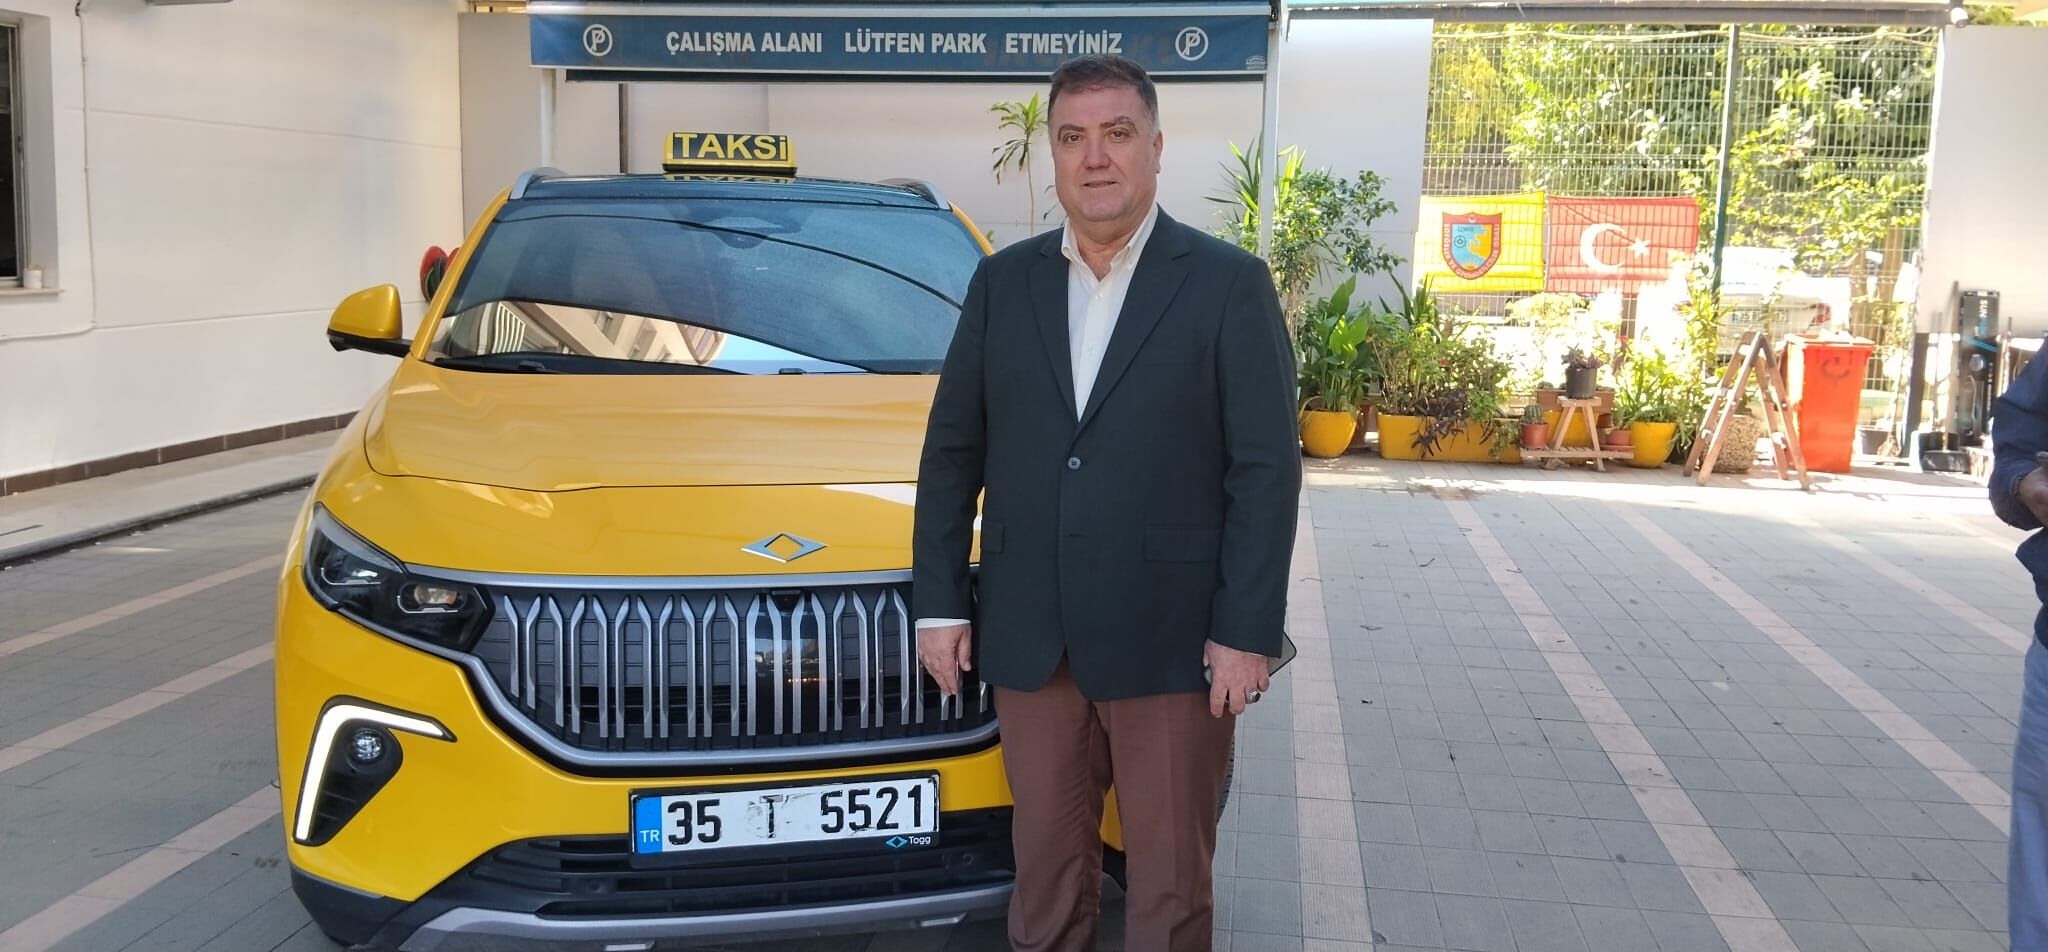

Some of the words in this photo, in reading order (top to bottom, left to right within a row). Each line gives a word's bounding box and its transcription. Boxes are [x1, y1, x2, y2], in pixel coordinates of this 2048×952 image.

[666, 31, 756, 56] ÇALIŞMA
[761, 32, 823, 53] ALANI
[844, 28, 925, 53] LÜTFEN
[931, 32, 988, 54] PARK
[1005, 29, 1123, 54] ETMEYİNİZ
[667, 799, 721, 845] 35
[820, 784, 922, 833] 5521
[640, 829, 660, 843] TR
[908, 836, 931, 845] Togg
